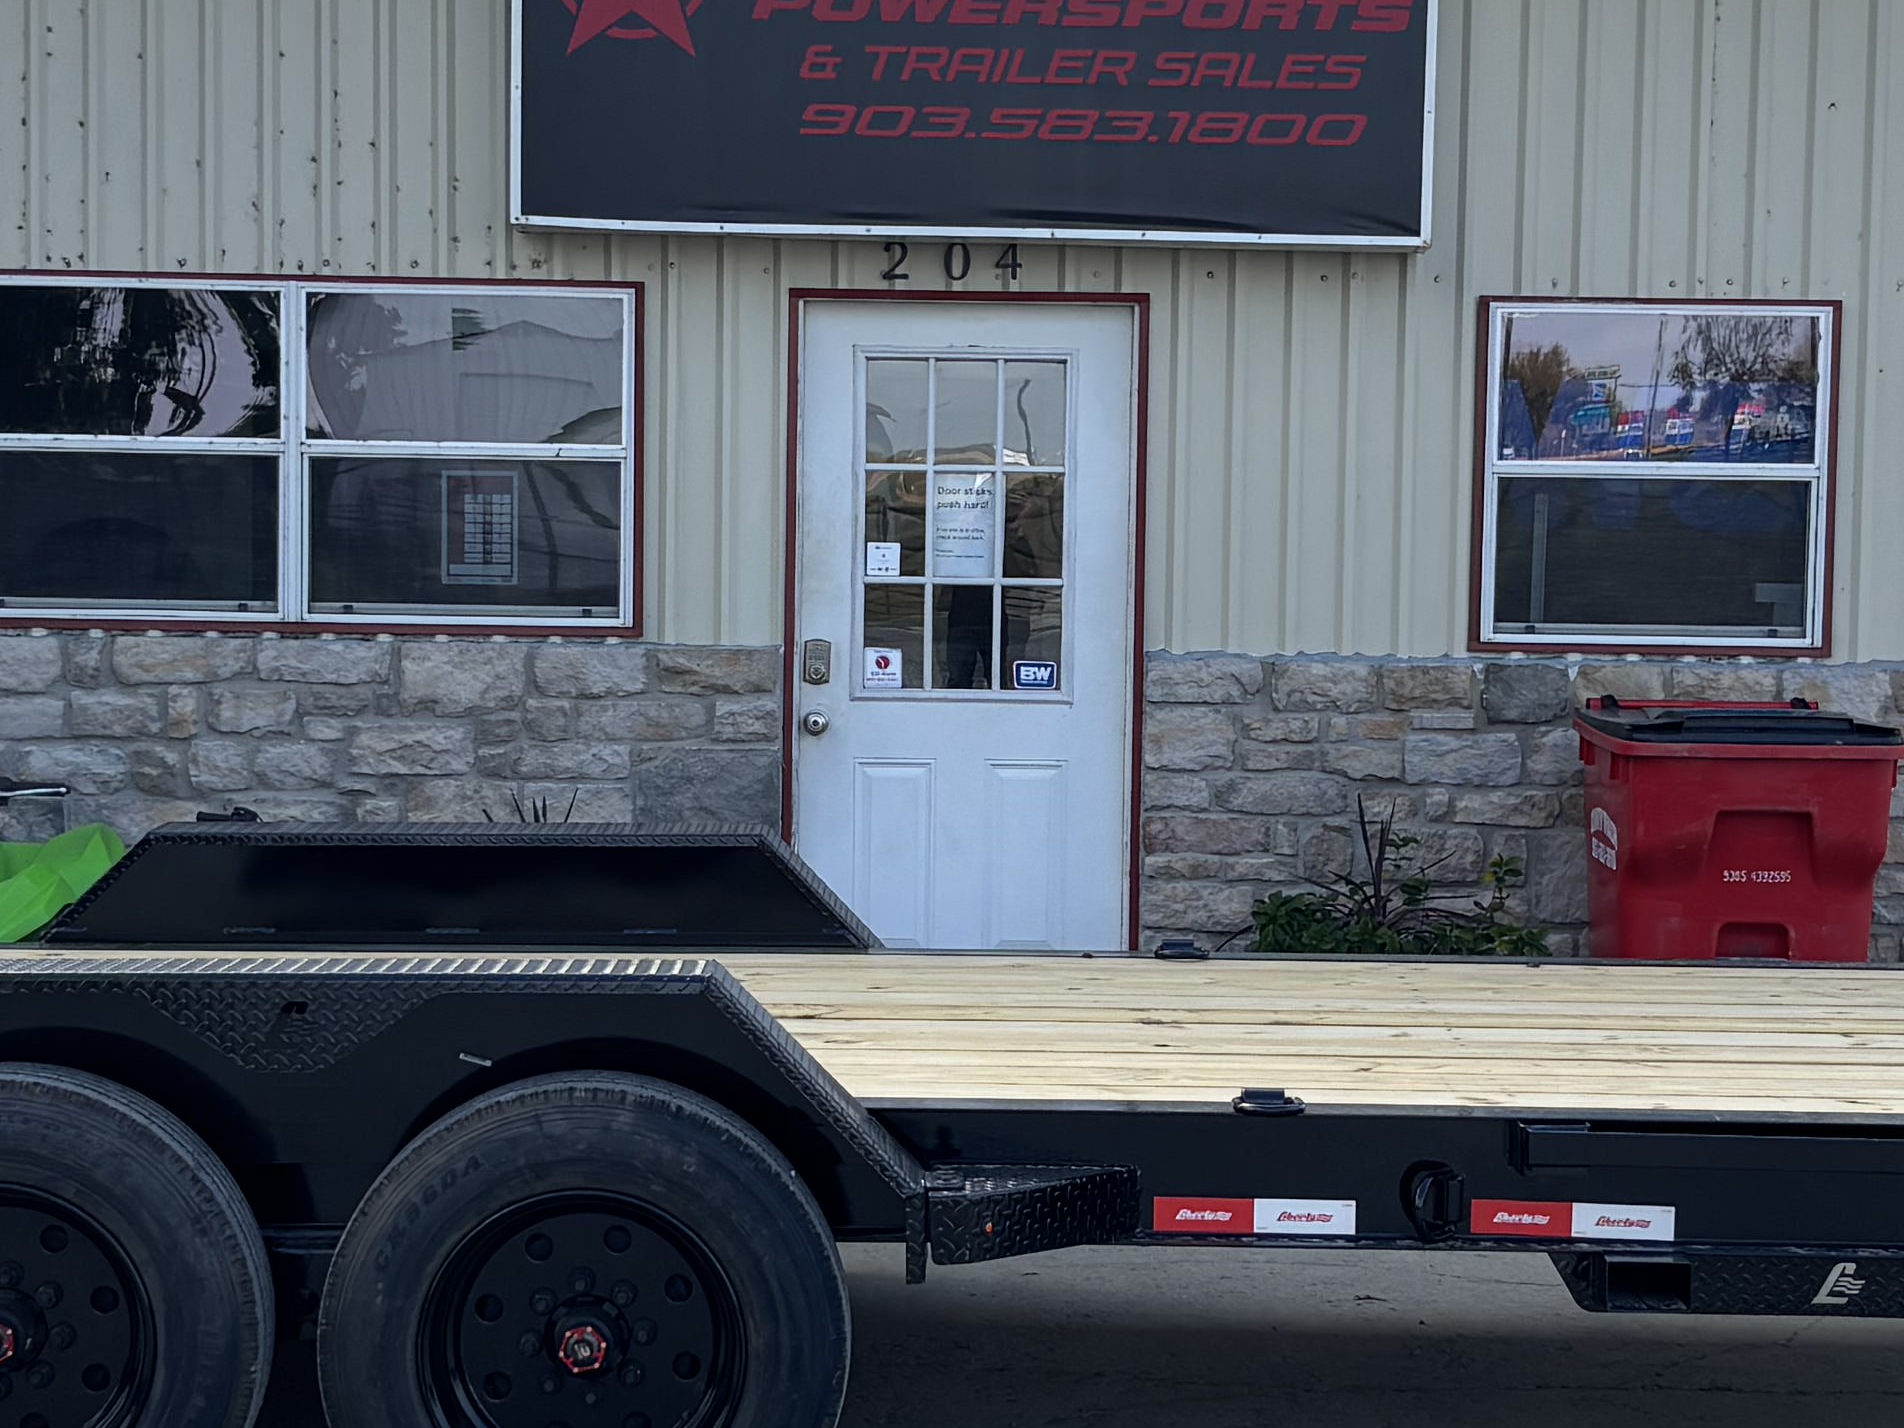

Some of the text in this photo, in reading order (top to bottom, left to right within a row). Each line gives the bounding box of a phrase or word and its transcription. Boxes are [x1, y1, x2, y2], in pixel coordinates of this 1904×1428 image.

[799, 45, 1367, 91] & TRAILER SALES
[799, 103, 1369, 147] 903.583.1800
